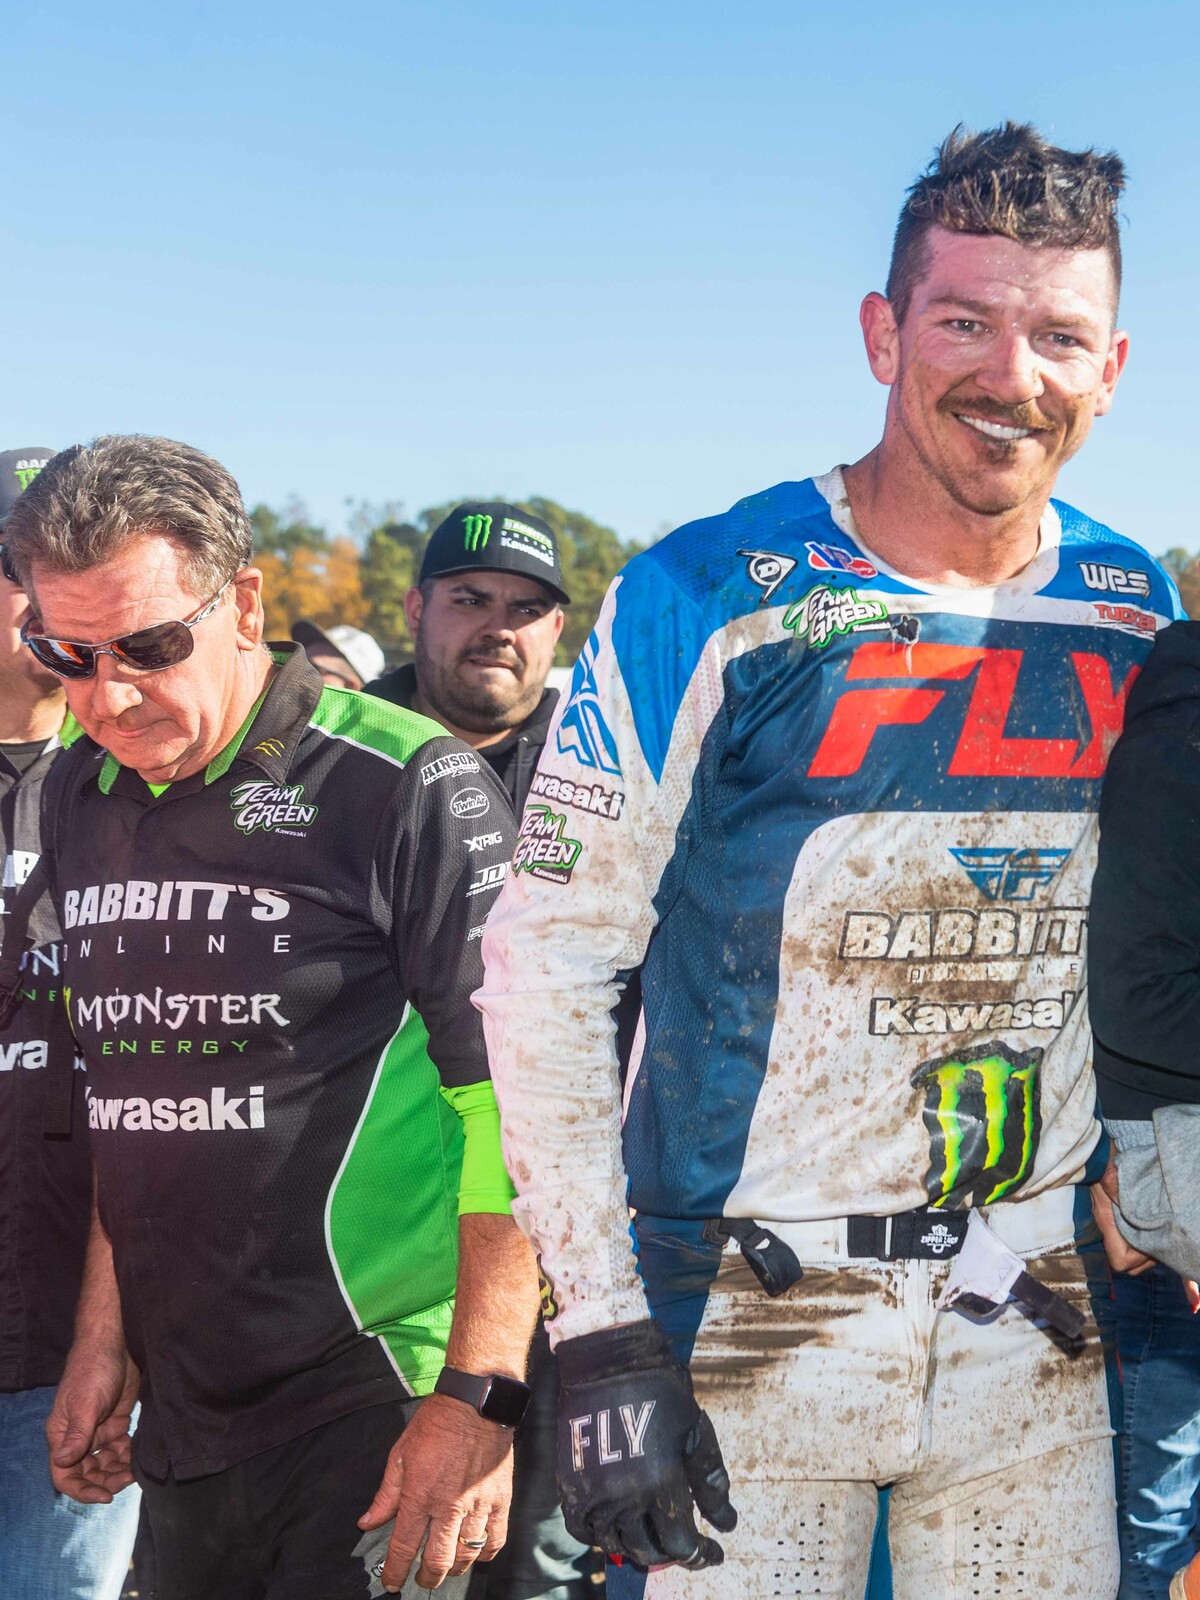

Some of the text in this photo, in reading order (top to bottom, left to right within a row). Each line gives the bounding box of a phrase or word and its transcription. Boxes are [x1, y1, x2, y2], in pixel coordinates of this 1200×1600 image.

[1077, 562, 1151, 599] WPS
[787, 587, 856, 635] TEAM
[811, 604, 883, 645] GREEN
[1094, 604, 1157, 632] TUCKER
[807, 642, 1141, 778] FLY
[421, 752, 480, 785] HINSON
[234, 783, 300, 806] TEAM
[531, 772, 624, 820] wasaki
[237, 803, 315, 831] GREEN
[520, 810, 562, 841] TEAM
[462, 831, 503, 853] XTRIG
[514, 836, 577, 869] GREEN
[469, 860, 512, 890] JD
[533, 867, 568, 883] Kawasaki
[64, 880, 291, 929] BABBITT'S
[838, 907, 1089, 961] BABBITT
[908, 962, 1078, 984] ONLNE
[77, 986, 290, 1032] MONSTER
[869, 990, 1076, 1036] Kawasa
[102, 1040, 249, 1055] ENERGY
[85, 1086, 265, 1132] awasaki
[569, 1400, 656, 1472] FLY
